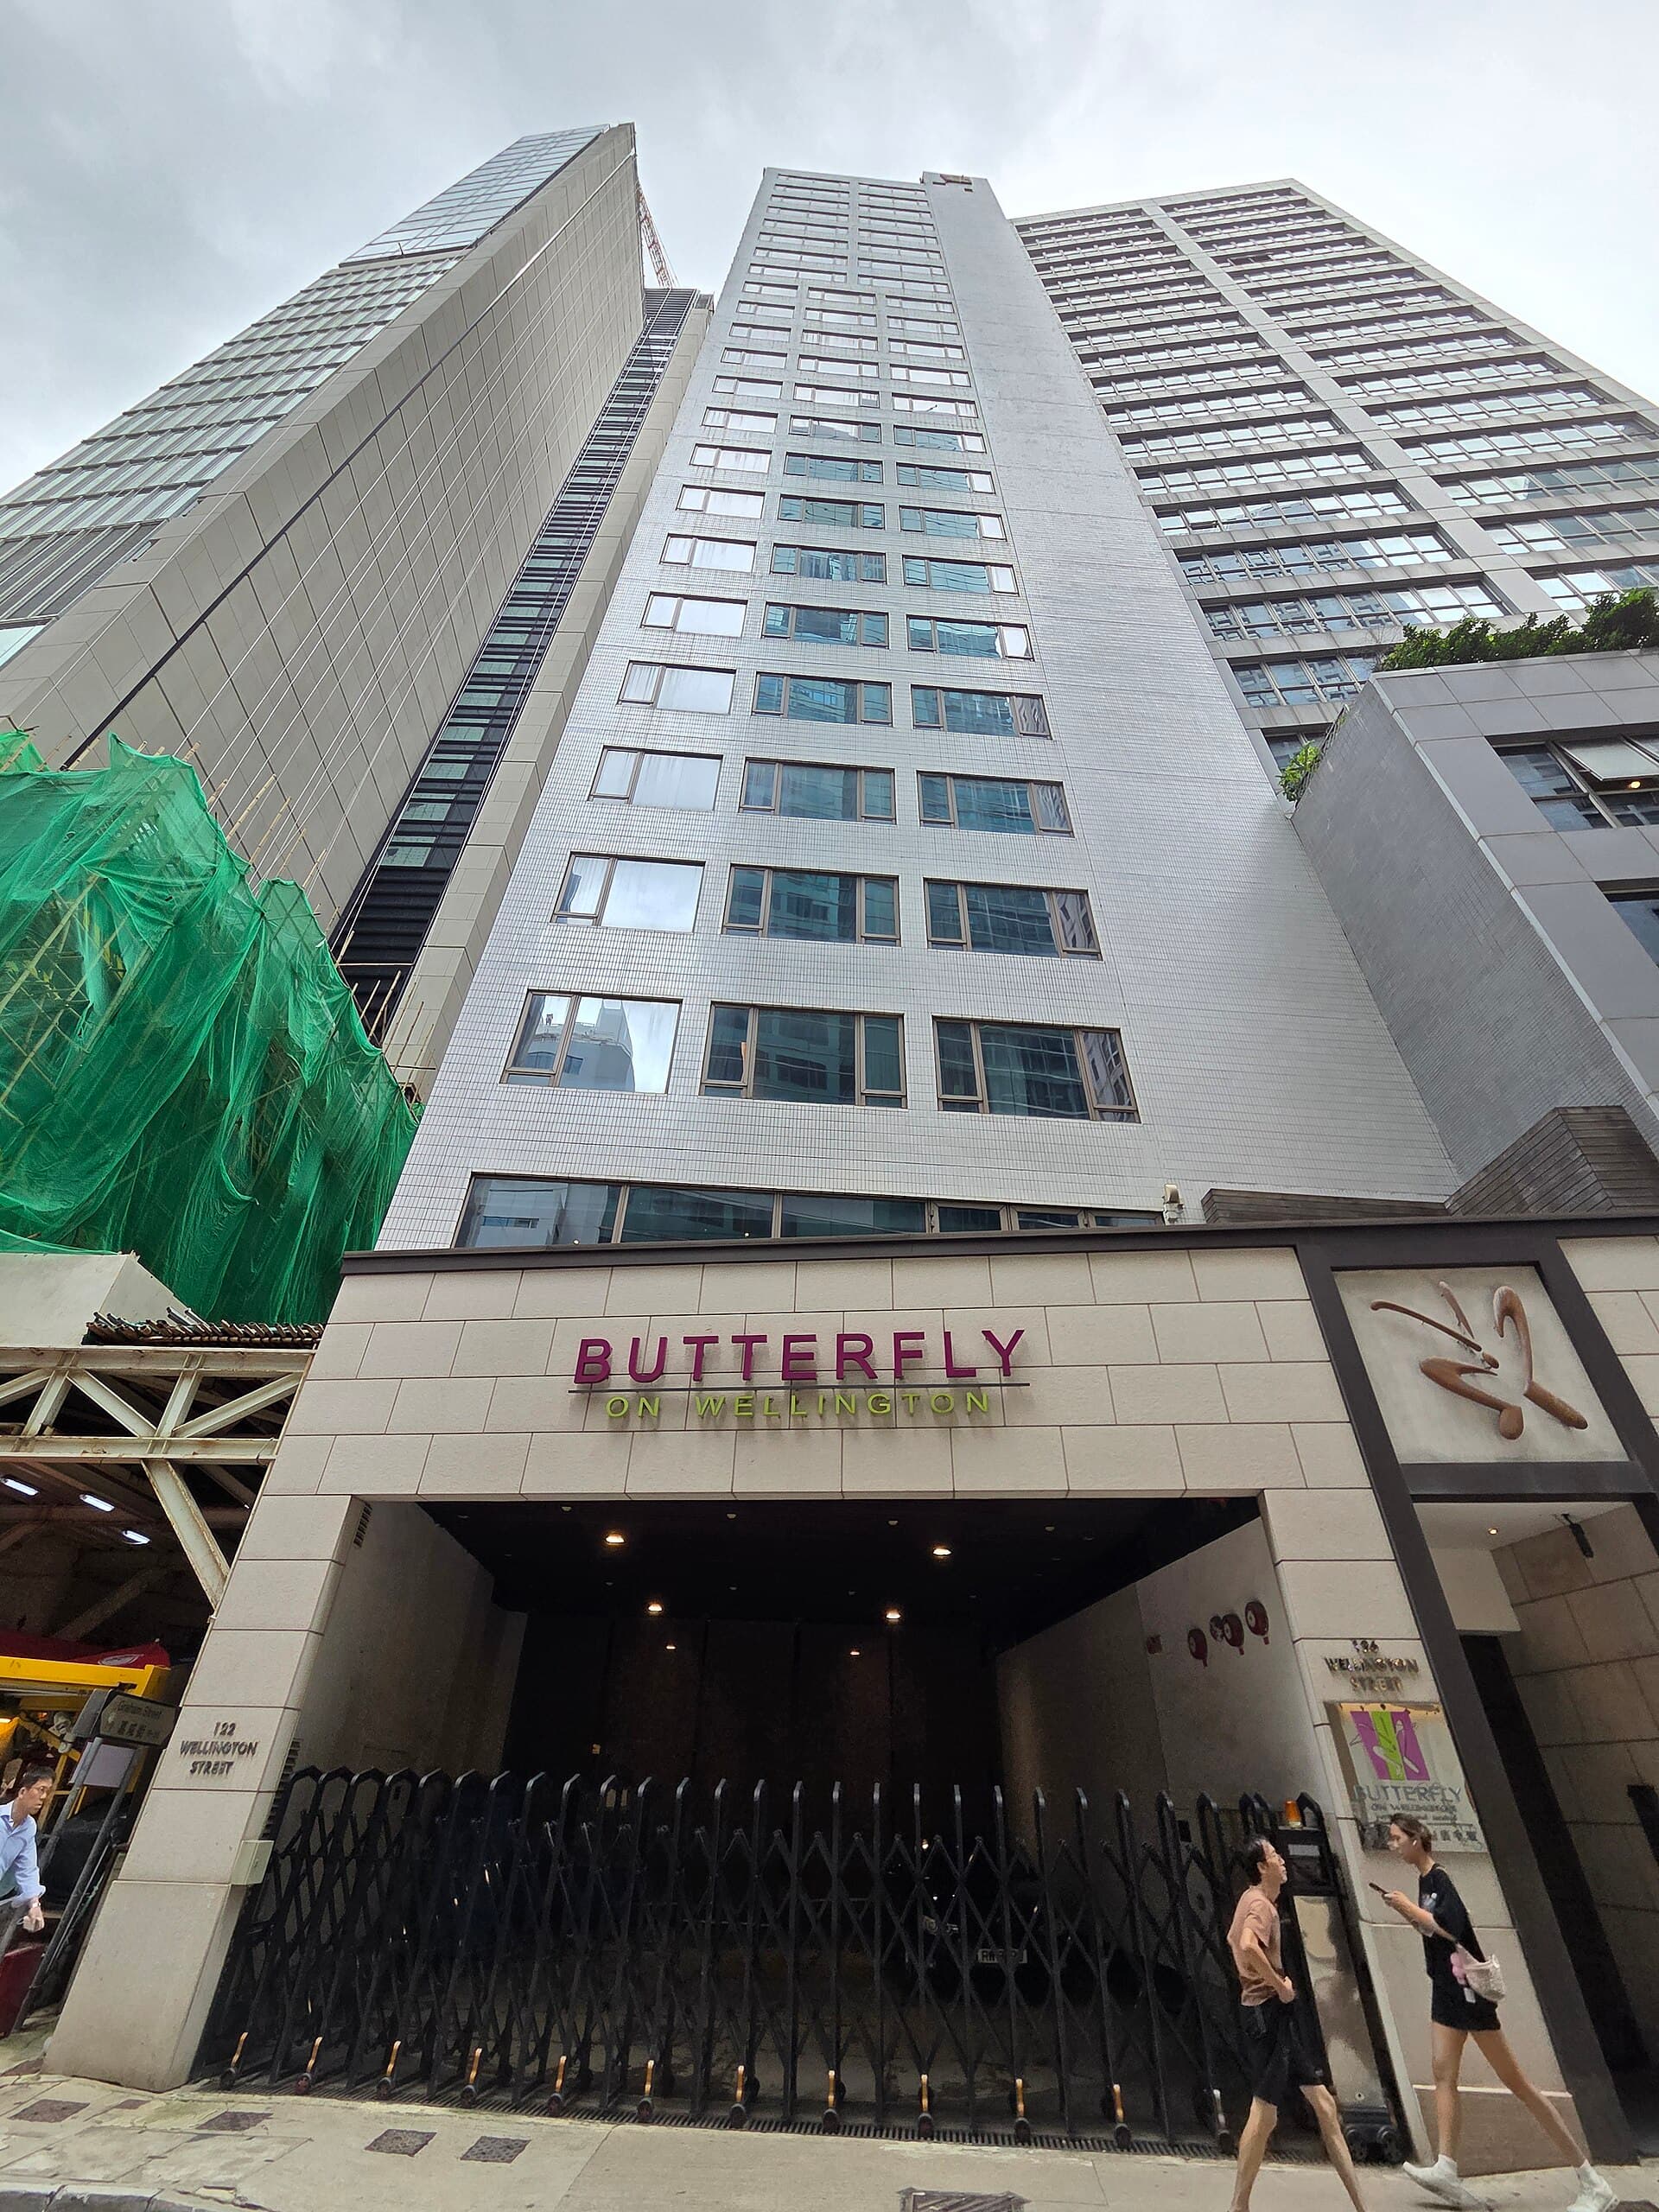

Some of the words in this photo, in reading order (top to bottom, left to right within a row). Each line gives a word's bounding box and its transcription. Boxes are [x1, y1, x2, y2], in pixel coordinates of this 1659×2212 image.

[573, 1329, 1026, 1384] BUTTERFLY
[606, 1395, 661, 1419] ON
[696, 1392, 990, 1418] WELLINGTON
[1324, 1658, 1419, 1673] WELLINGTON
[1350, 1676, 1403, 1691] STREET
[213, 1721, 236, 1736] 122
[180, 1740, 258, 1756] WELLINGTON
[190, 1761, 233, 1776] STREET
[1352, 1783, 1462, 1802] BUTTERFLY
